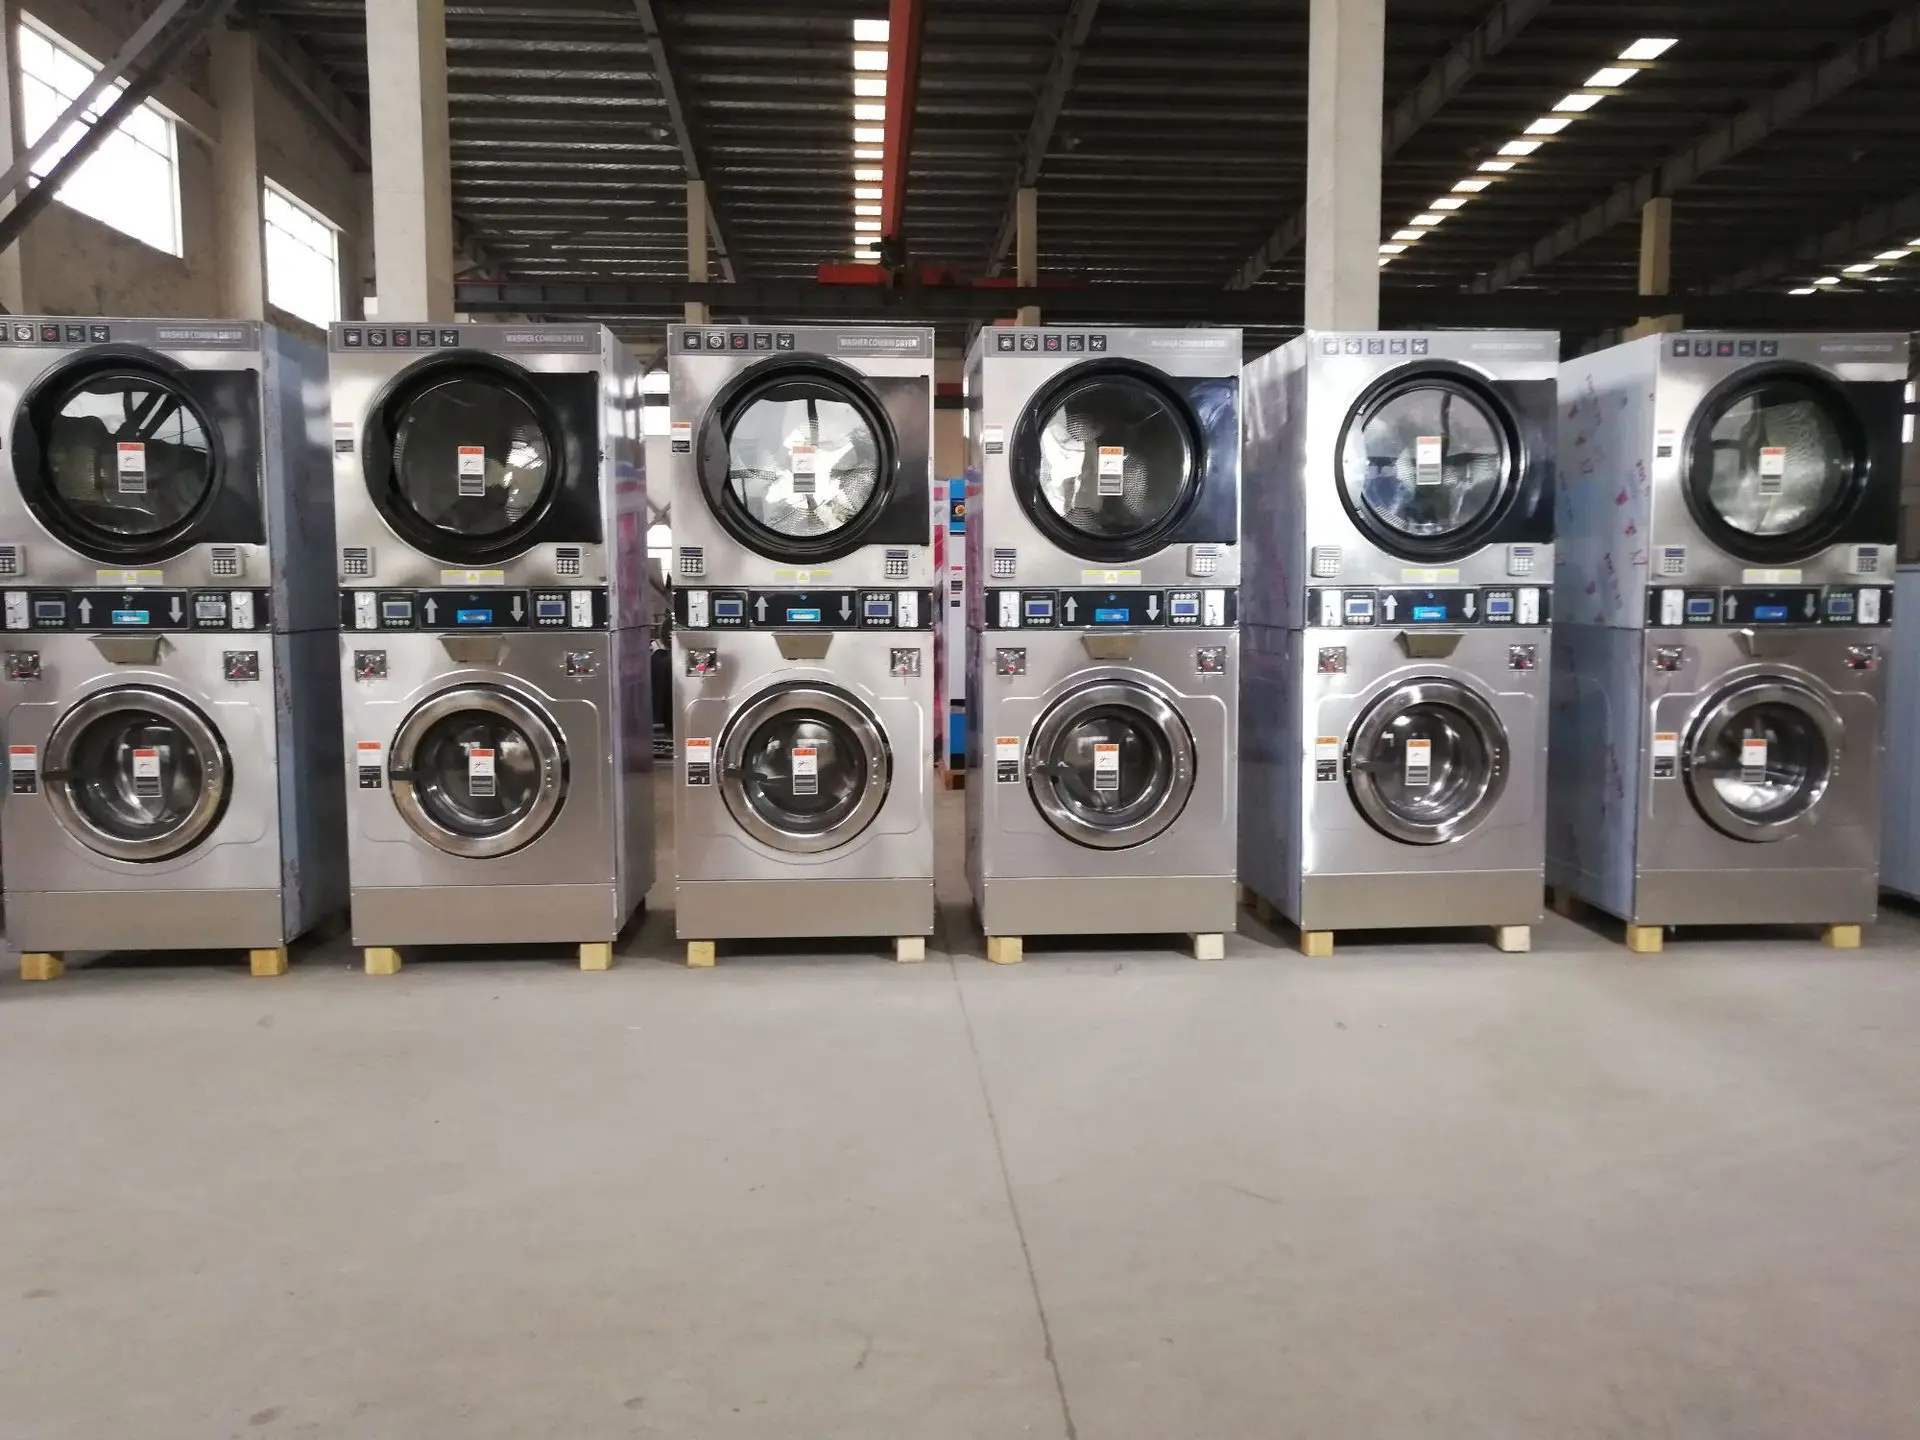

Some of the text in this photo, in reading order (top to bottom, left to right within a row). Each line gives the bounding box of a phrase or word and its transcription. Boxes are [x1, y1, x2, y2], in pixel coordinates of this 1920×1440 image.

[505, 334, 534, 343] WASHER
[839, 338, 868, 347] WASHER
[895, 339, 918, 348] DRYER
